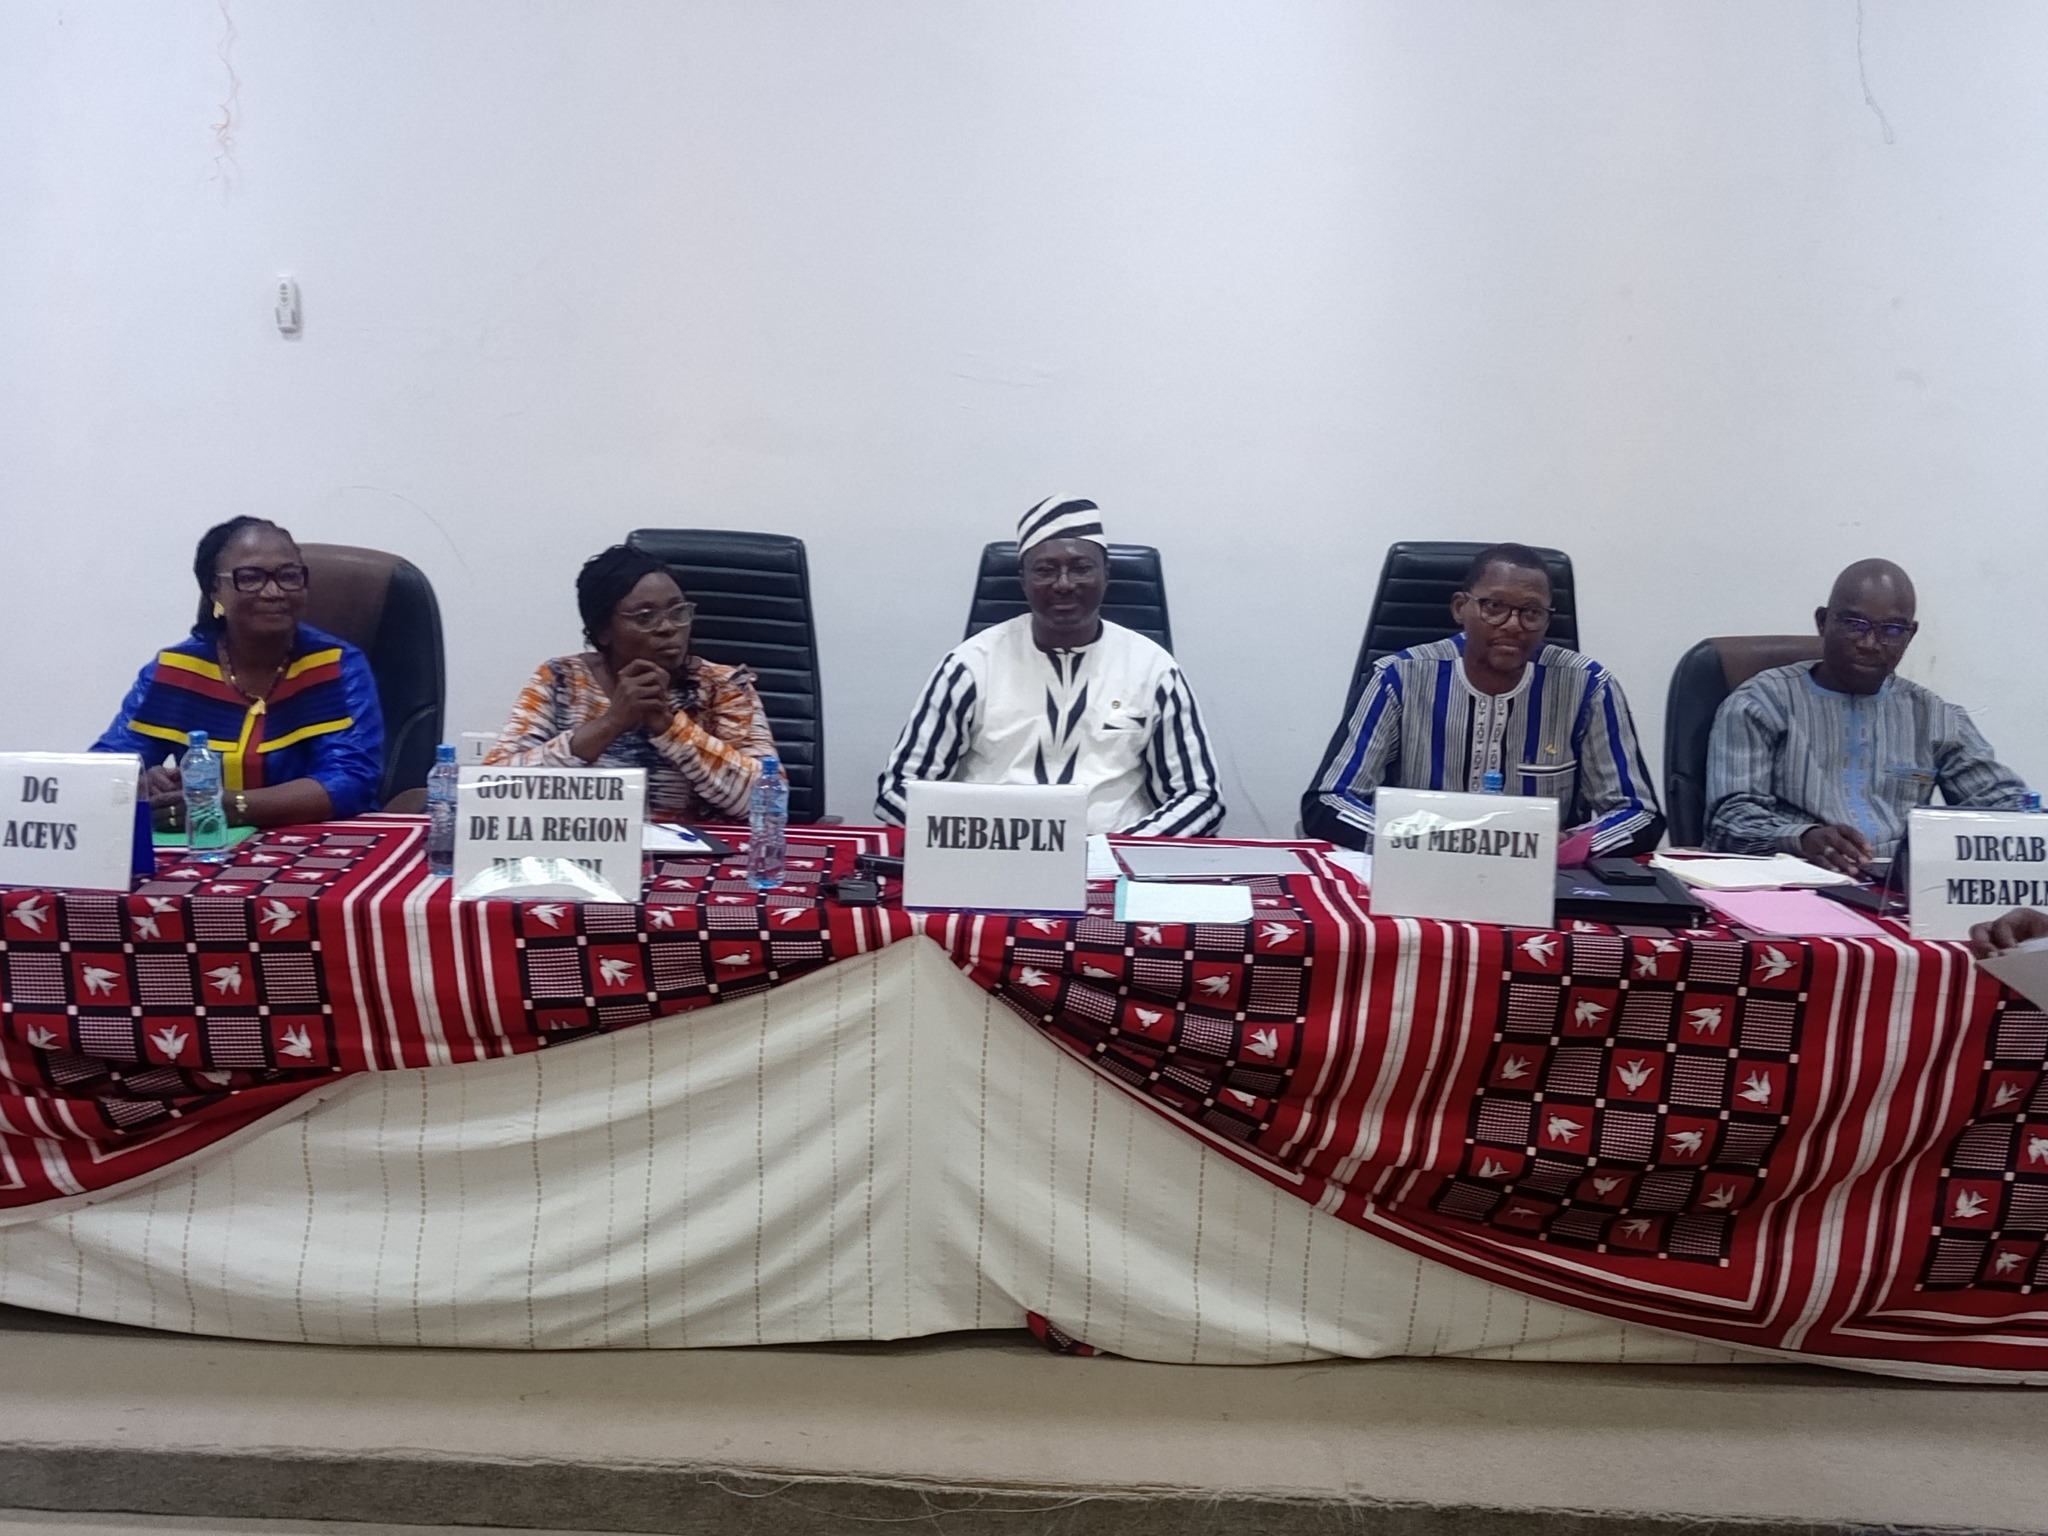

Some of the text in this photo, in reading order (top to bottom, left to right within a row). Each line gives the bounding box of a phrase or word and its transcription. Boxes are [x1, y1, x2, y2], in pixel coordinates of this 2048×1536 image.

[21, 775, 59, 804] DG
[476, 774, 624, 801] GOUVERNEUR
[3, 820, 77, 850] ACEVS
[469, 815, 629, 842] DE LA REGION
[926, 815, 1067, 852] MEBAPLN
[1427, 825, 1540, 859] MEBAPLN
[1954, 834, 2047, 862] DIRCAB
